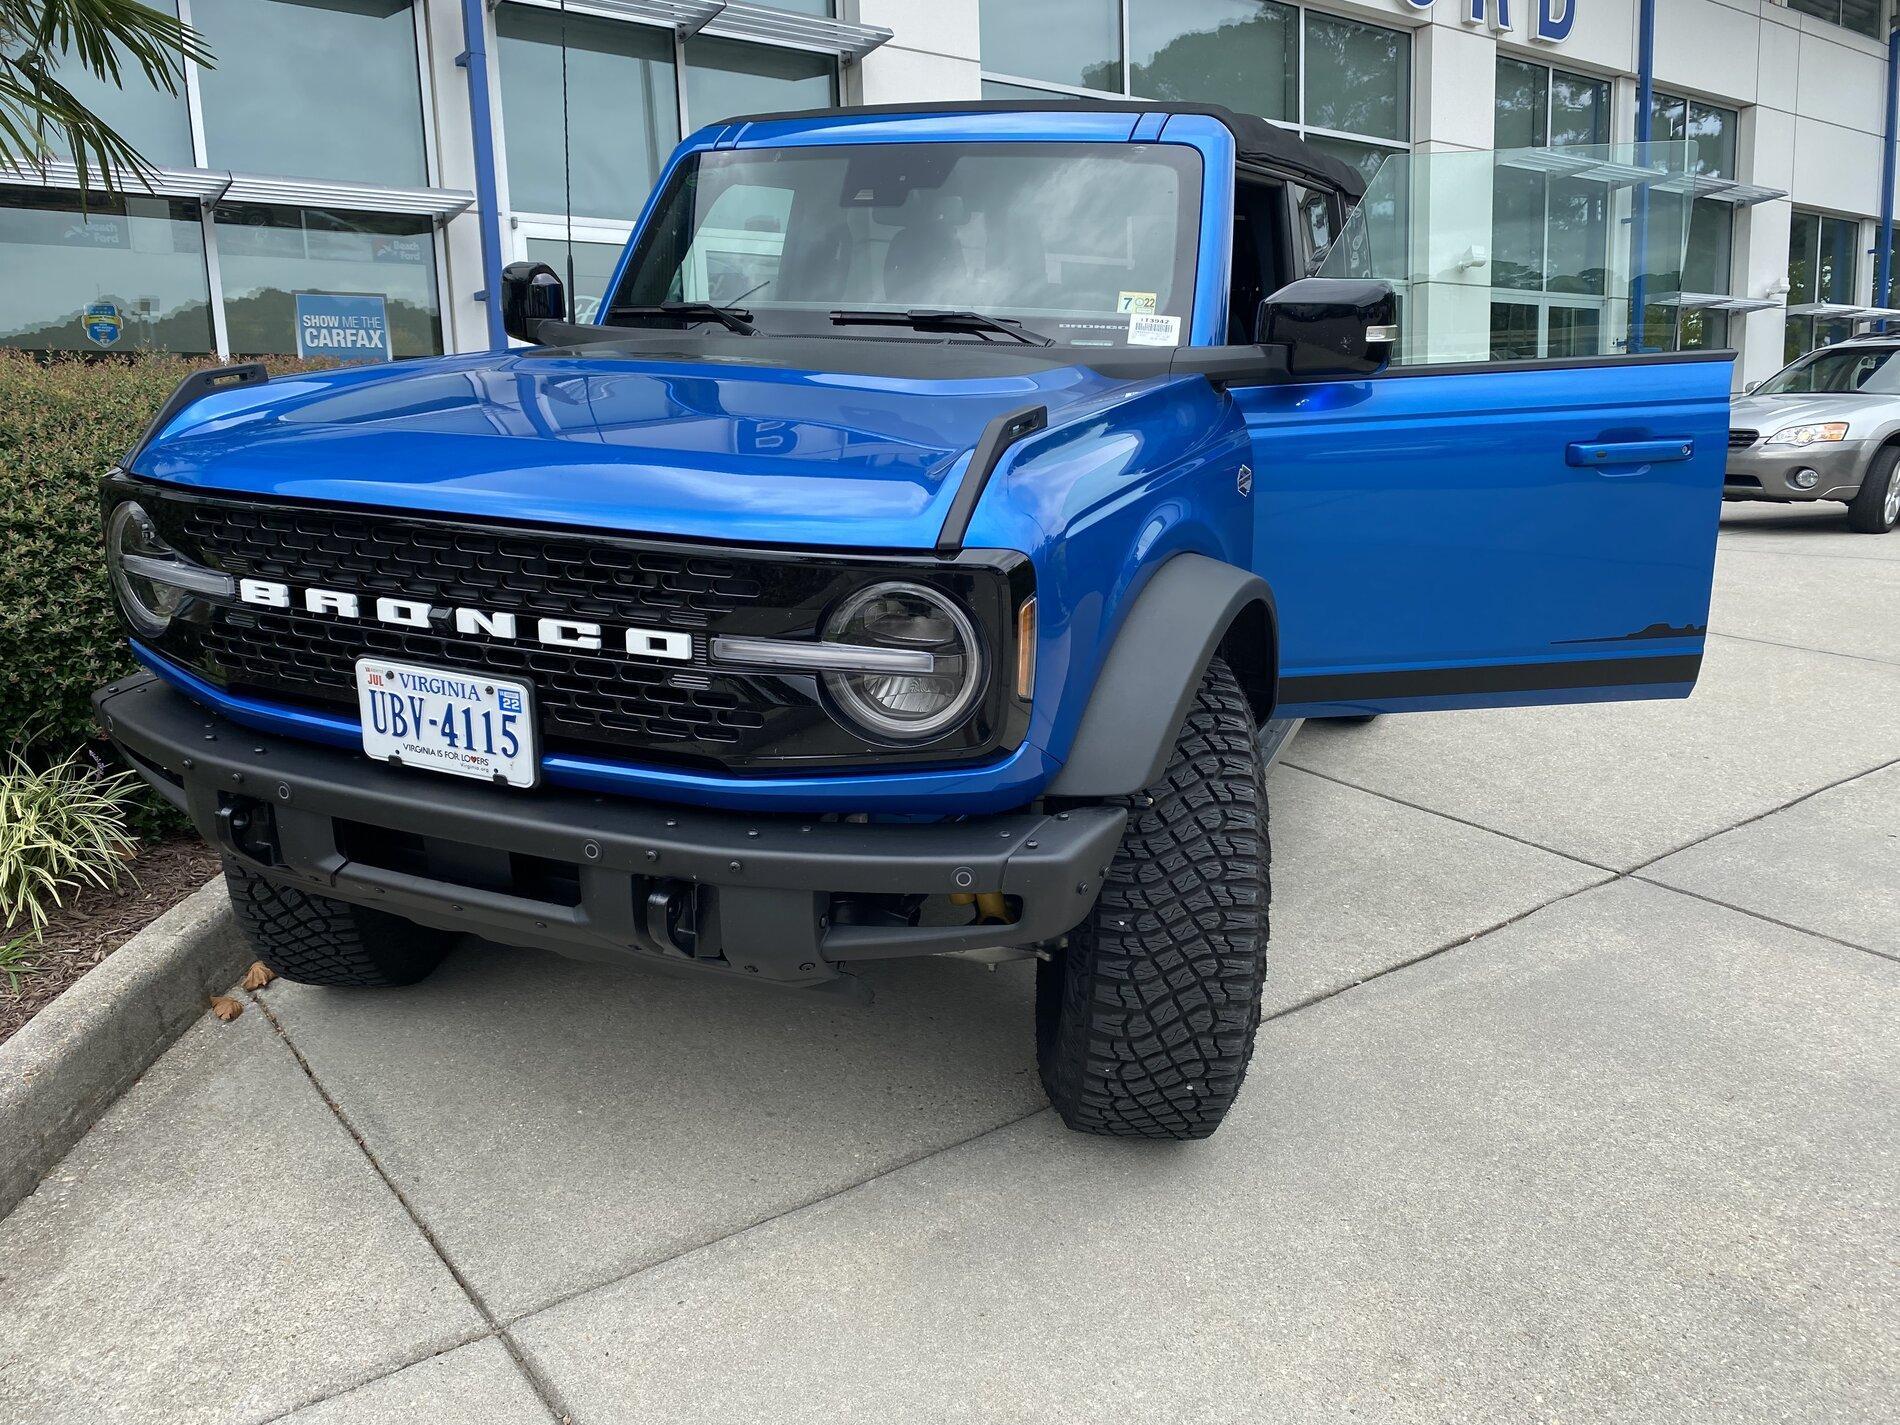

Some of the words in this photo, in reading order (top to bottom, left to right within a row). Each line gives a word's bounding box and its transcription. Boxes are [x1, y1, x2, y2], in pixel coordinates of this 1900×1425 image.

[1123, 297, 1133, 310] 7
[1143, 297, 1155, 308] 22
[303, 314, 339, 327] SHOW
[342, 316, 359, 329] ME
[361, 316, 382, 329] THE
[305, 328, 383, 348] CARFAX
[239, 578, 693, 661] BRONCO
[367, 674, 384, 687] JUL
[398, 672, 482, 702] VIRGINIA
[502, 697, 520, 710] 22
[368, 688, 519, 759] UBV-4115
[402, 742, 436, 757] VIRGINIA
[437, 749, 443, 758] IS
[444, 751, 460, 761] FOR
